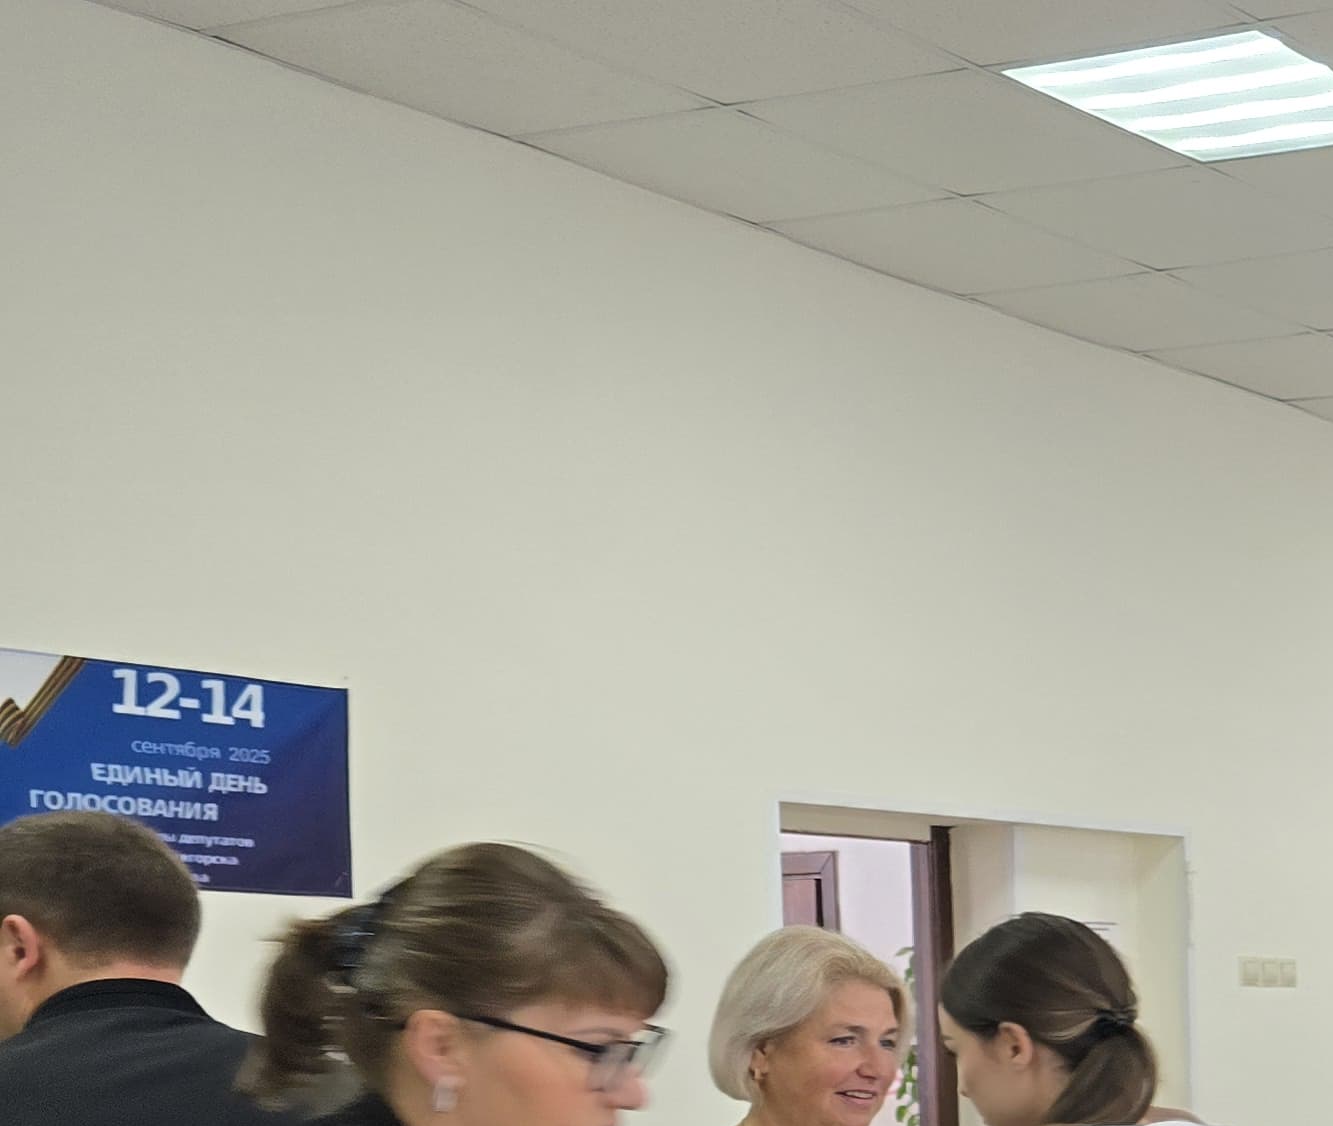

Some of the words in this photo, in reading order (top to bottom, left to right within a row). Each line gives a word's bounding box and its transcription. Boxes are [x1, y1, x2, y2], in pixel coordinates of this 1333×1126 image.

[112, 669, 265, 728] 12-14
[131, 740, 222, 760] сентября
[229, 747, 271, 764] 2025
[90, 762, 202, 789] ЕДИНЫЙ
[208, 772, 268, 795] ДЕНЬ
[29, 789, 219, 821] ГОЛОСОВАНИЯ
